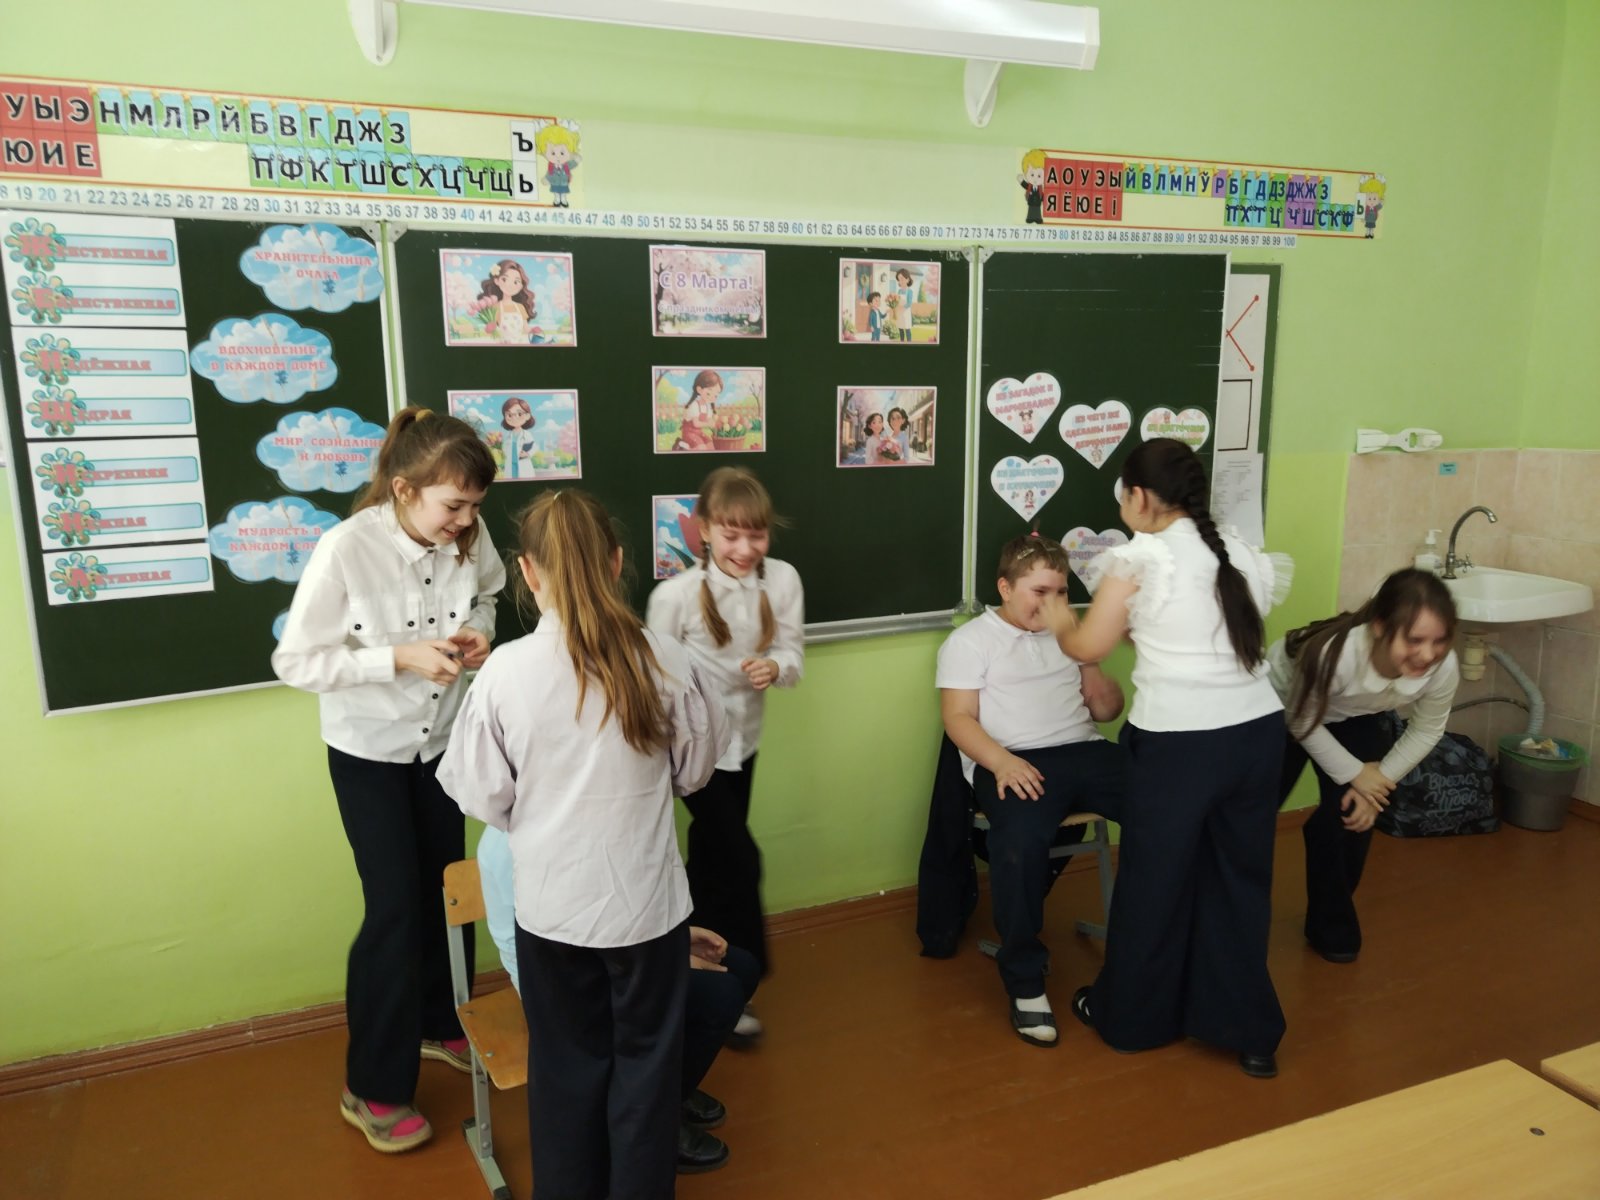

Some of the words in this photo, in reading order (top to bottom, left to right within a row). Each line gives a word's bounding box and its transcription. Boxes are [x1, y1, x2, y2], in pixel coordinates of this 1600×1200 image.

[5, 95, 24, 117] У
[35, 97, 60, 120] Ы
[70, 99, 90, 121] Э
[100, 101, 120, 123] Н
[130, 104, 153, 125] М
[163, 106, 182, 128] Л
[193, 108, 210, 130] Р
[221, 105, 241, 132] Й
[251, 113, 268, 133] Б
[279, 115, 298, 136] В
[309, 116, 323, 138] Г
[334, 119, 355, 145] Д
[358, 120, 382, 143] Ж
[391, 123, 405, 143] З
[513, 132, 534, 152] Ъ
[5, 140, 34, 163] Ю
[42, 142, 64, 165] И
[77, 144, 94, 167] Е
[255, 158, 274, 179] П
[280, 158, 303, 181] Ф
[312, 161, 329, 183] К
[337, 163, 353, 184] Т
[361, 163, 386, 186] Ш
[391, 165, 408, 187] С
[418, 166, 436, 188] Х
[441, 167, 462, 194] Ц
[468, 169, 485, 191] Ч
[490, 170, 513, 196] Щ
[519, 173, 534, 193] Ь
[86, 190, 106, 204] 22
[110, 191, 128, 205] 23
[132, 192, 150, 206] 24
[154, 194, 172, 208] 25
[176, 195, 194, 208] 26
[200, 196, 214, 209] 27
[222, 197, 238, 210] 28
[244, 198, 260, 212] 29
[264, 199, 280, 213] 30
[284, 200, 300, 213] 31
[304, 201, 320, 214] 32
[324, 202, 342, 215] 33
[345, 203, 362, 216] 34
[366, 204, 382, 217] 35
[386, 204, 402, 218] 36
[406, 205, 420, 219] 37
[424, 206, 438, 220] 38
[442, 206, 456, 220] 39
[460, 208, 476, 221] 40
[478, 209, 492, 222] 41
[498, 210, 514, 223] 42
[516, 211, 530, 224] 43
[568, 213, 582, 226] 46
[585, 213, 598, 226] 47
[602, 214, 616, 226] 48
[620, 215, 634, 227] 49
[638, 215, 650, 228] 50
[653, 216, 666, 228] 51
[668, 217, 682, 229] 52
[684, 217, 698, 229] 53
[700, 218, 714, 230] 54
[716, 219, 729, 231] 55
[732, 219, 746, 231] 56
[748, 220, 760, 232] 57
[763, 221, 776, 232] 58
[778, 221, 790, 233] 59
[792, 222, 804, 233] 60
[806, 223, 818, 234] 61
[822, 223, 834, 234] 62
[836, 224, 848, 235] 63
[852, 225, 864, 235] 64
[866, 225, 877, 235] 65
[878, 225, 890, 236] 66
[892, 225, 904, 236] 67
[906, 226, 918, 237] 68
[919, 226, 930, 237] 69
[932, 226, 944, 238] 70
[946, 226, 957, 238] 71
[255, 251, 372, 266] ХРАНИТЕЛЬНИЦА
[296, 270, 339, 279] ОЧАГА
[660, 272, 671, 288] С
[676, 273, 686, 288] 8
[692, 274, 753, 293] Марта!
[218, 346, 317, 355] ВДОХНОВЕНИЕ
[225, 361, 286, 371] КАЖДОМ
[291, 361, 327, 370] ДОМЕ
[314, 453, 366, 462] ЛЮБОВЬ
[238, 528, 308, 536] МУДРОСТЬ
[230, 543, 289, 551] КАЖДОМ
